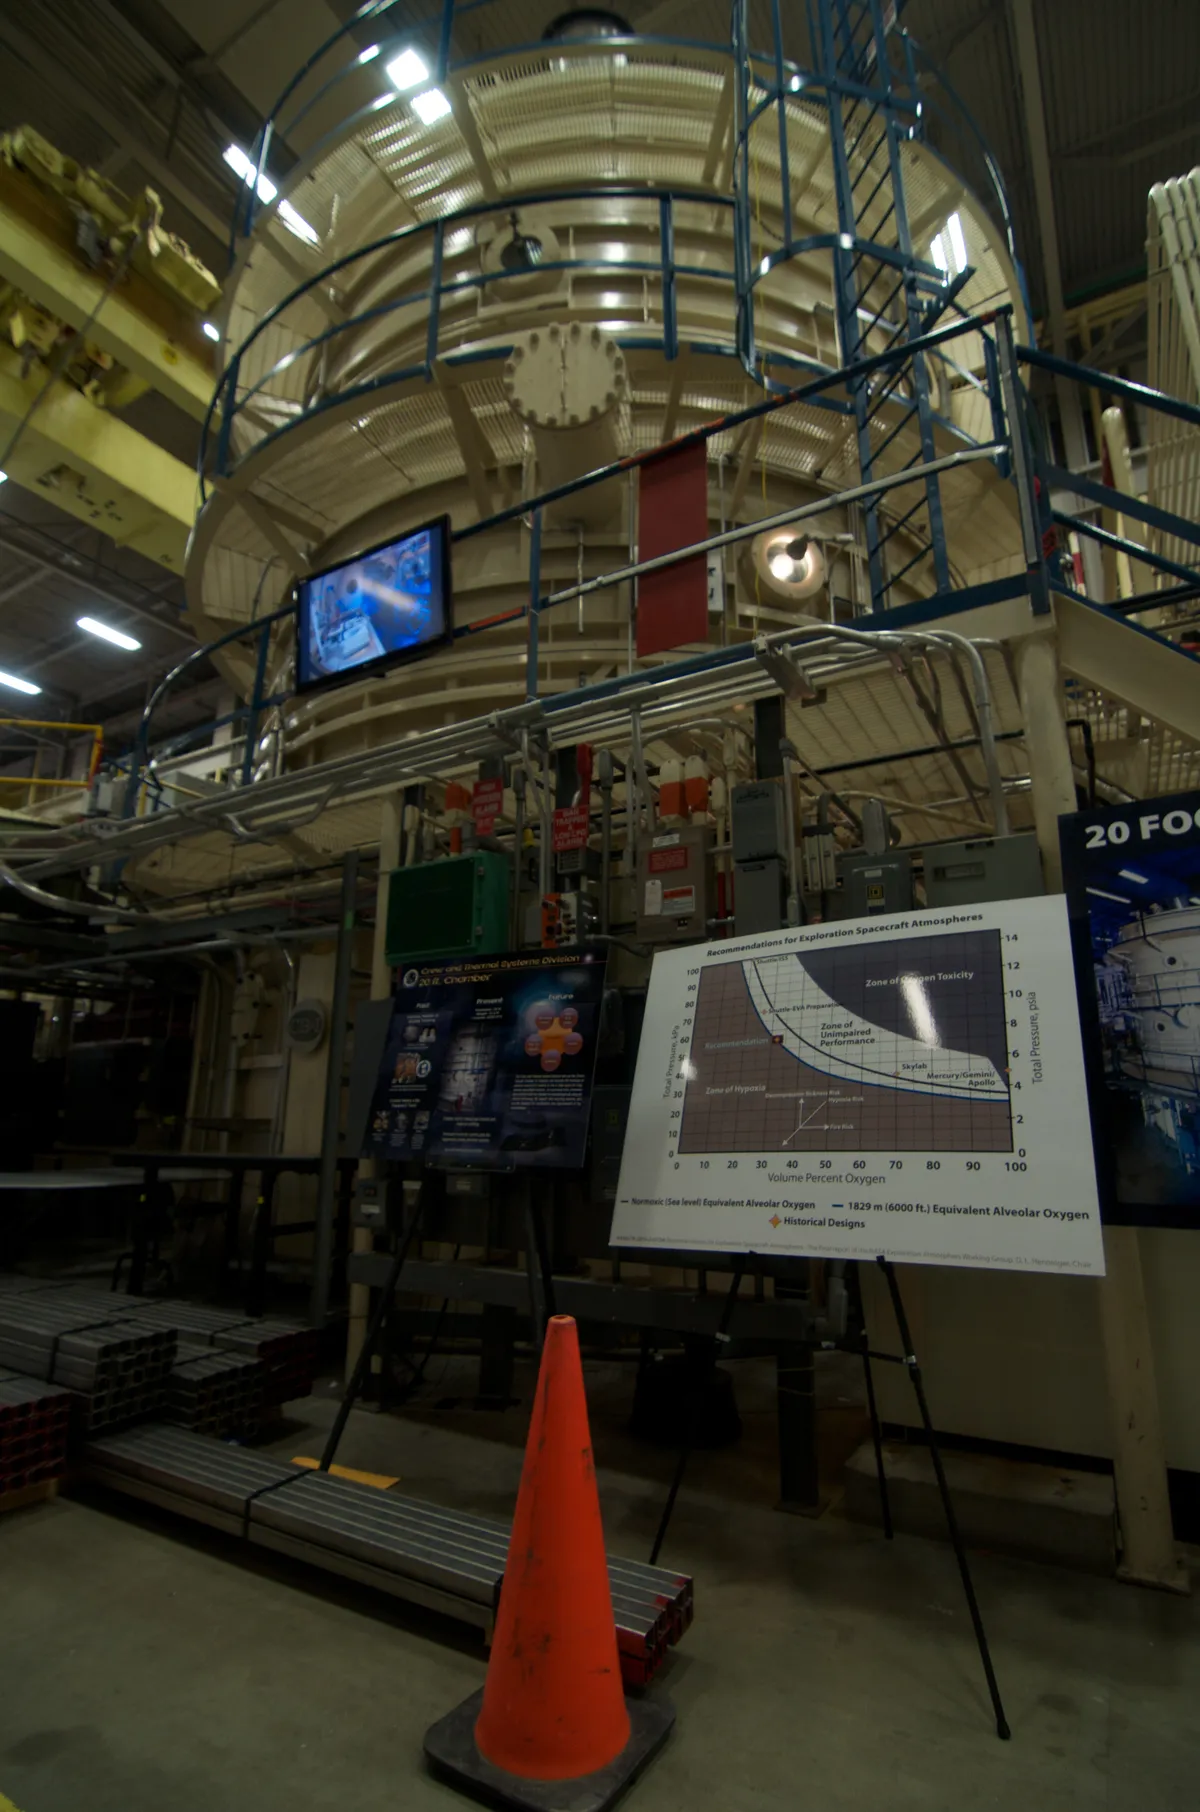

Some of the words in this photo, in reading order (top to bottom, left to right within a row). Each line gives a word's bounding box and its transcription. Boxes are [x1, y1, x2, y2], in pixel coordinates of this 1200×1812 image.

[1085, 821, 1130, 849] 20
[1139, 807, 1200, 840] FO
[707, 941, 782, 957] Recommendations
[784, 937, 798, 945] for
[800, 929, 854, 943] Exploration
[856, 921, 909, 935] Spacecraft
[911, 914, 983, 928] Atmospheres
[1006, 934, 1018, 942] 14
[421, 967, 443, 975] Crew
[464, 961, 499, 971] Thermal
[501, 958, 540, 969] Systems
[541, 955, 580, 965] Division
[1007, 962, 1020, 970] 12
[687, 968, 700, 976] 100
[419, 978, 430, 987] 20
[444, 973, 492, 985] Chamber
[865, 979, 888, 988] Zone
[889, 976, 899, 985] of
[937, 970, 975, 981] Toxicity
[687, 984, 697, 992] 90
[548, 993, 575, 1001] Future
[1009, 989, 1022, 998] 10
[476, 996, 504, 1005] Present
[684, 1001, 694, 1009] 80
[1027, 991, 1039, 1011] psia
[768, 1004, 806, 1014] Shuttle-EVA
[806, 1001, 844, 1011] Preparation
[682, 1018, 692, 1026] 70
[844, 1021, 853, 1029] of
[1010, 1019, 1017, 1027] 8
[671, 1025, 680, 1040] kPa
[821, 1028, 871, 1040] Unimpaired
[1029, 1013, 1040, 1056] Pressure,
[680, 1036, 690, 1044] 60
[704, 1037, 769, 1050] Recommendation
[820, 1037, 875, 1047] Performance
[1012, 1049, 1020, 1058] 6
[666, 1041, 678, 1077] Pressure,
[902, 1062, 928, 1071] Skylab
[927, 1071, 995, 1080] Mercury/Gemini/
[1030, 1059, 1042, 1084] Total
[662, 1077, 672, 1098] Total
[968, 1079, 996, 1087] Apollo
[1014, 1081, 1022, 1090] 4
[706, 1086, 724, 1095] Zone
[725, 1084, 733, 1094] of
[734, 1083, 767, 1095] Hypoxia
[670, 1111, 680, 1119] 20
[1016, 1115, 1024, 1124] 2
[668, 1130, 678, 1138] 10
[668, 1150, 674, 1158] 0
[1018, 1149, 1026, 1158] 0
[674, 1162, 680, 1170] 0
[700, 1161, 710, 1169] 10
[727, 1160, 738, 1169] 20
[755, 1160, 768, 1169] 30
[786, 1160, 798, 1169] 40
[819, 1160, 832, 1169] 50
[853, 1160, 866, 1169] 60
[889, 1160, 903, 1170] 70
[926, 1161, 941, 1170] 80
[966, 1161, 981, 1171] 90
[1004, 1162, 1027, 1172] 100
[768, 1173, 803, 1183] Volume
[805, 1173, 843, 1183] Percent
[845, 1174, 886, 1186] Oxygen
[631, 1197, 664, 1206] Normoxic
[665, 1197, 680, 1207] (Sea
[681, 1197, 701, 1207] level)
[703, 1198, 744, 1209] Equivalent
[746, 1199, 780, 1208] Alveolar
[782, 1200, 815, 1211] Oxygen
[849, 1202, 872, 1211] 1829
[873, 1204, 883, 1212] m
[885, 1202, 914, 1213] (6000
[915, 1203, 931, 1214] ft.)
[933, 1204, 991, 1216] Equivalent
[993, 1206, 1041, 1218] Alveolar
[1043, 1208, 1090, 1222] Oxygen
[784, 1216, 826, 1227] Historical
[828, 1218, 866, 1230] Designs
[1072, 1259, 1093, 1269] Chair
